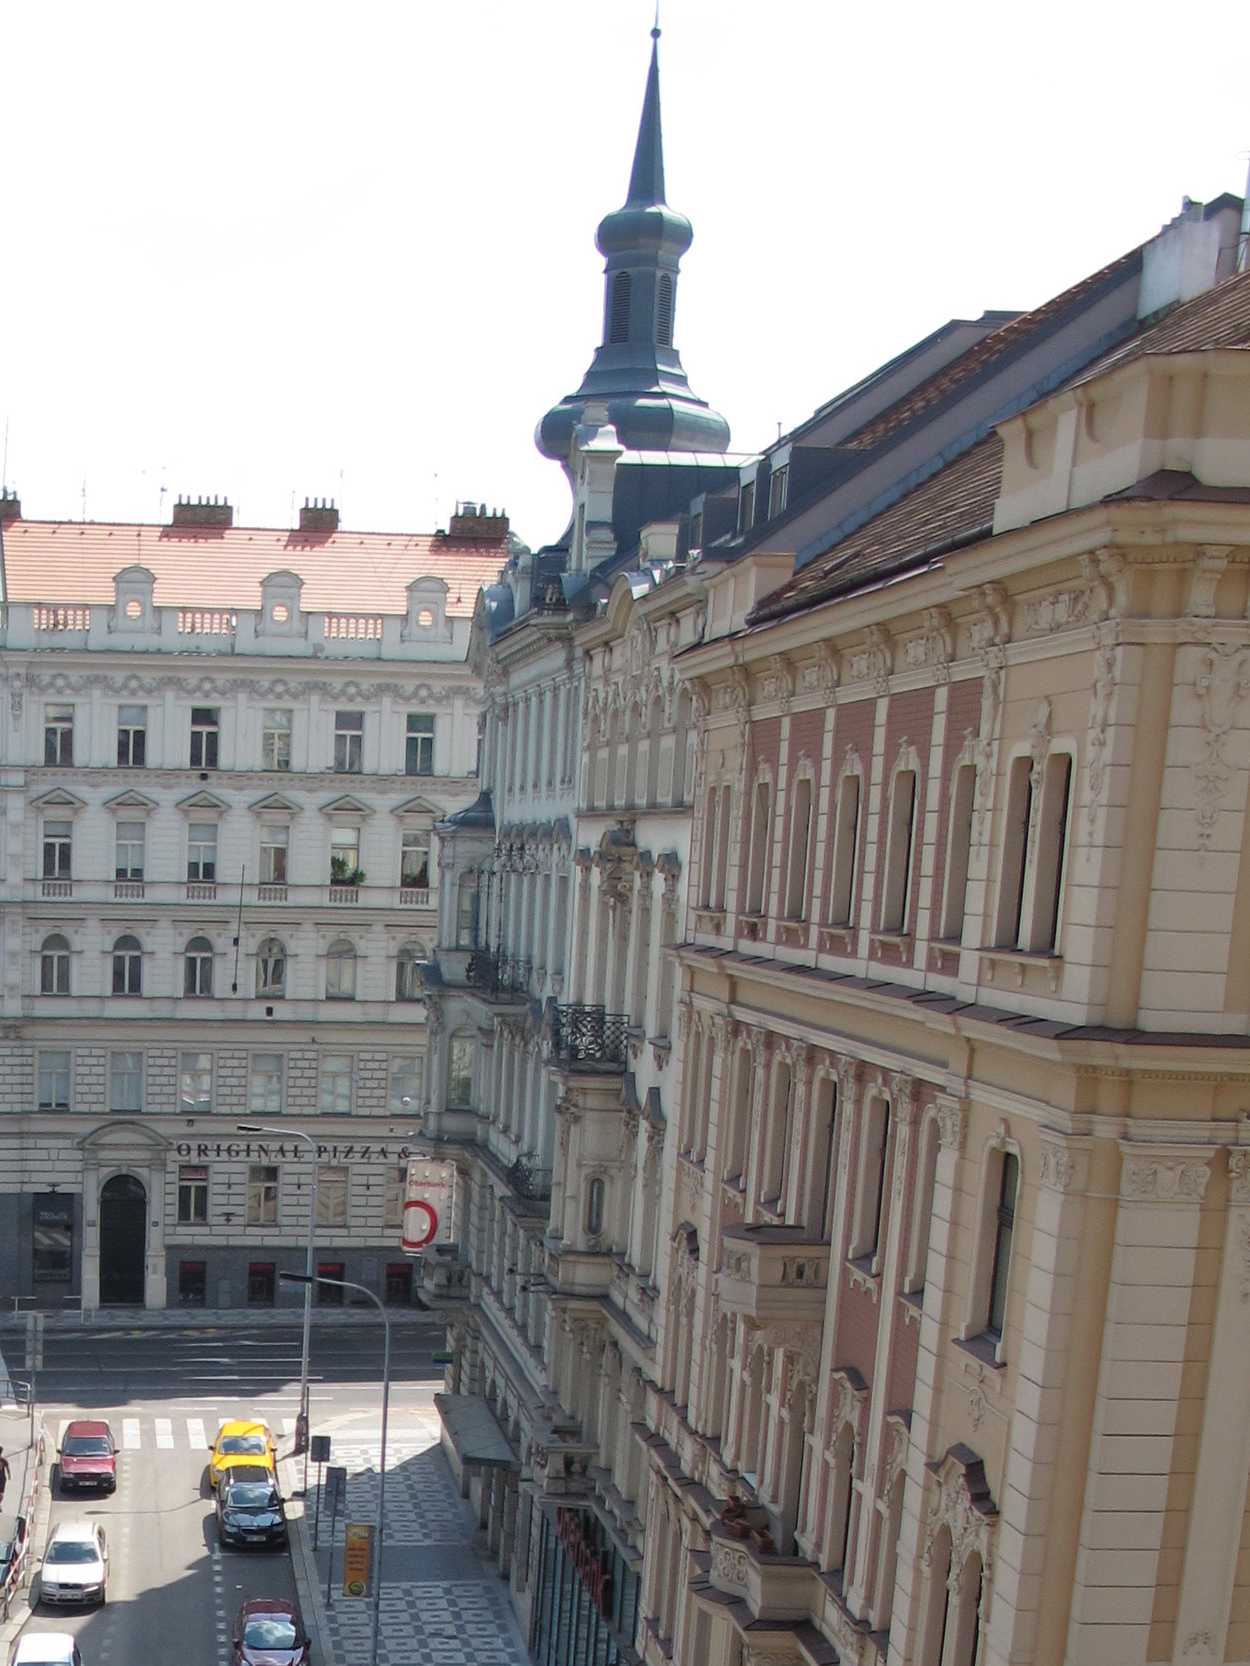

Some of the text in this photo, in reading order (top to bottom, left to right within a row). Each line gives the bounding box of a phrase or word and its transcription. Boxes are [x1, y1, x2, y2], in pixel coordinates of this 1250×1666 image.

[177, 1143, 306, 1158] ORIGINAL
[317, 1145, 389, 1160] PIZZA
[409, 1180, 445, 1188] Oberbank
